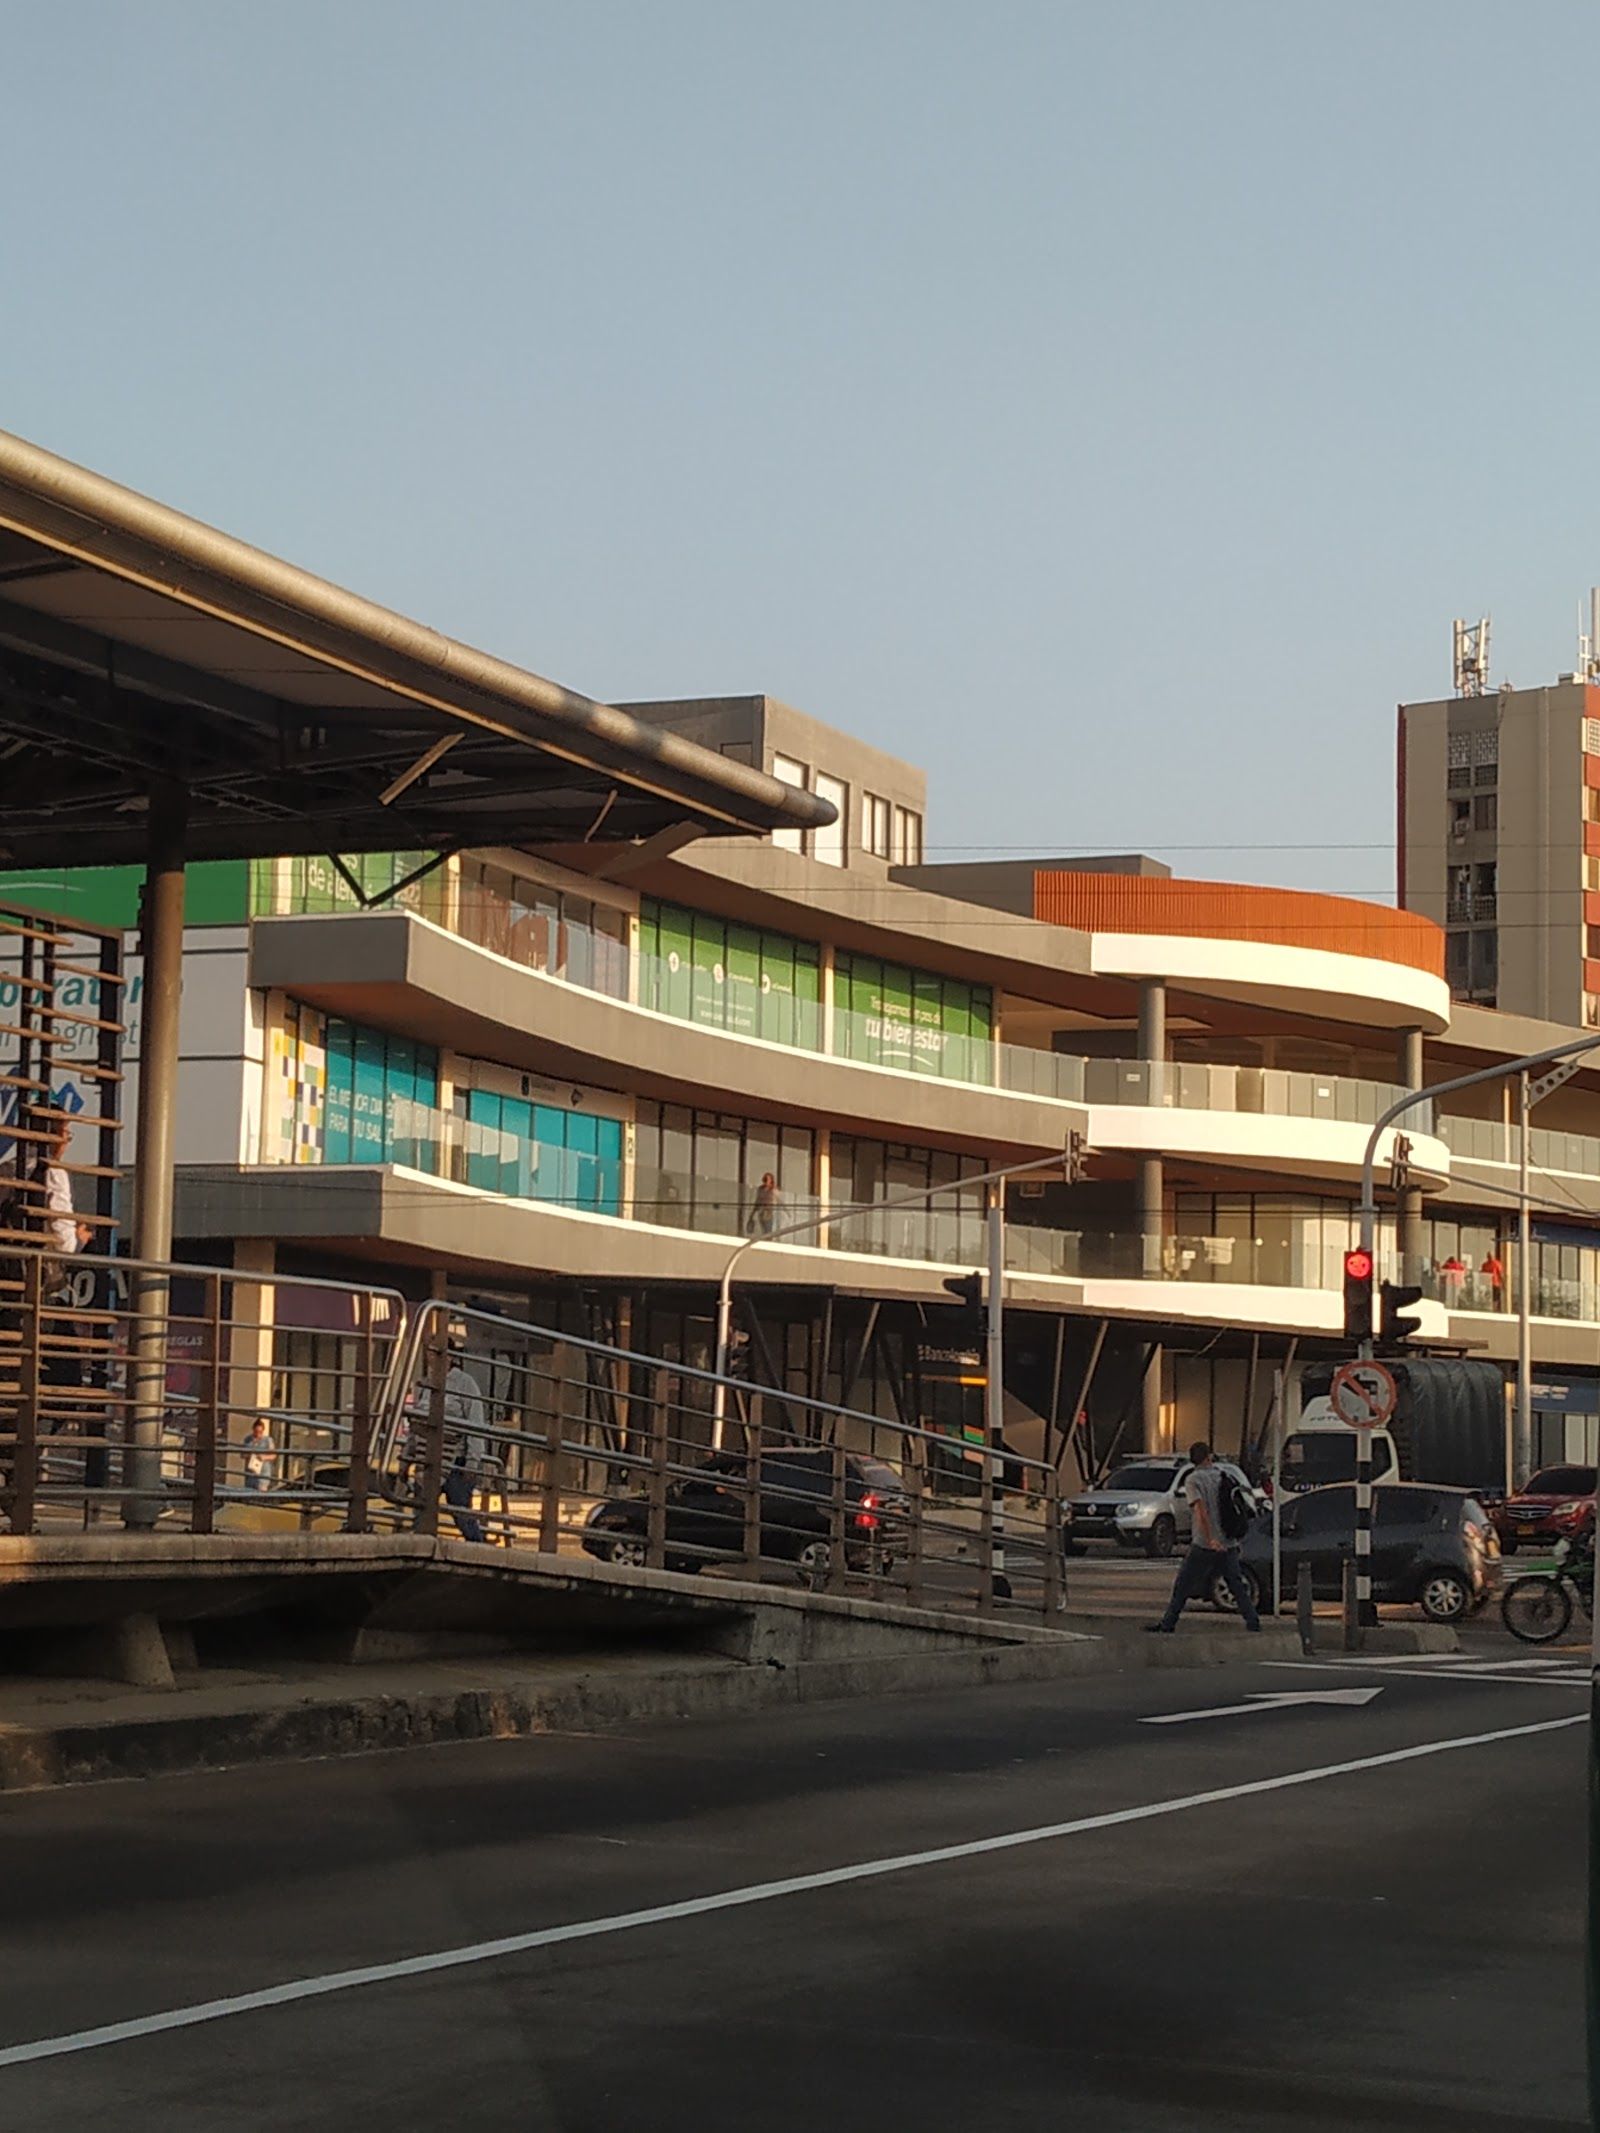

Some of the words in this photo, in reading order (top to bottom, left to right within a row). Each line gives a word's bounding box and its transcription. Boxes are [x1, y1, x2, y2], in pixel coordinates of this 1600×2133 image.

[865, 1018, 881, 1039] tu
[882, 1016, 949, 1052] bienestar
[339, 1089, 369, 1113] MEOR
